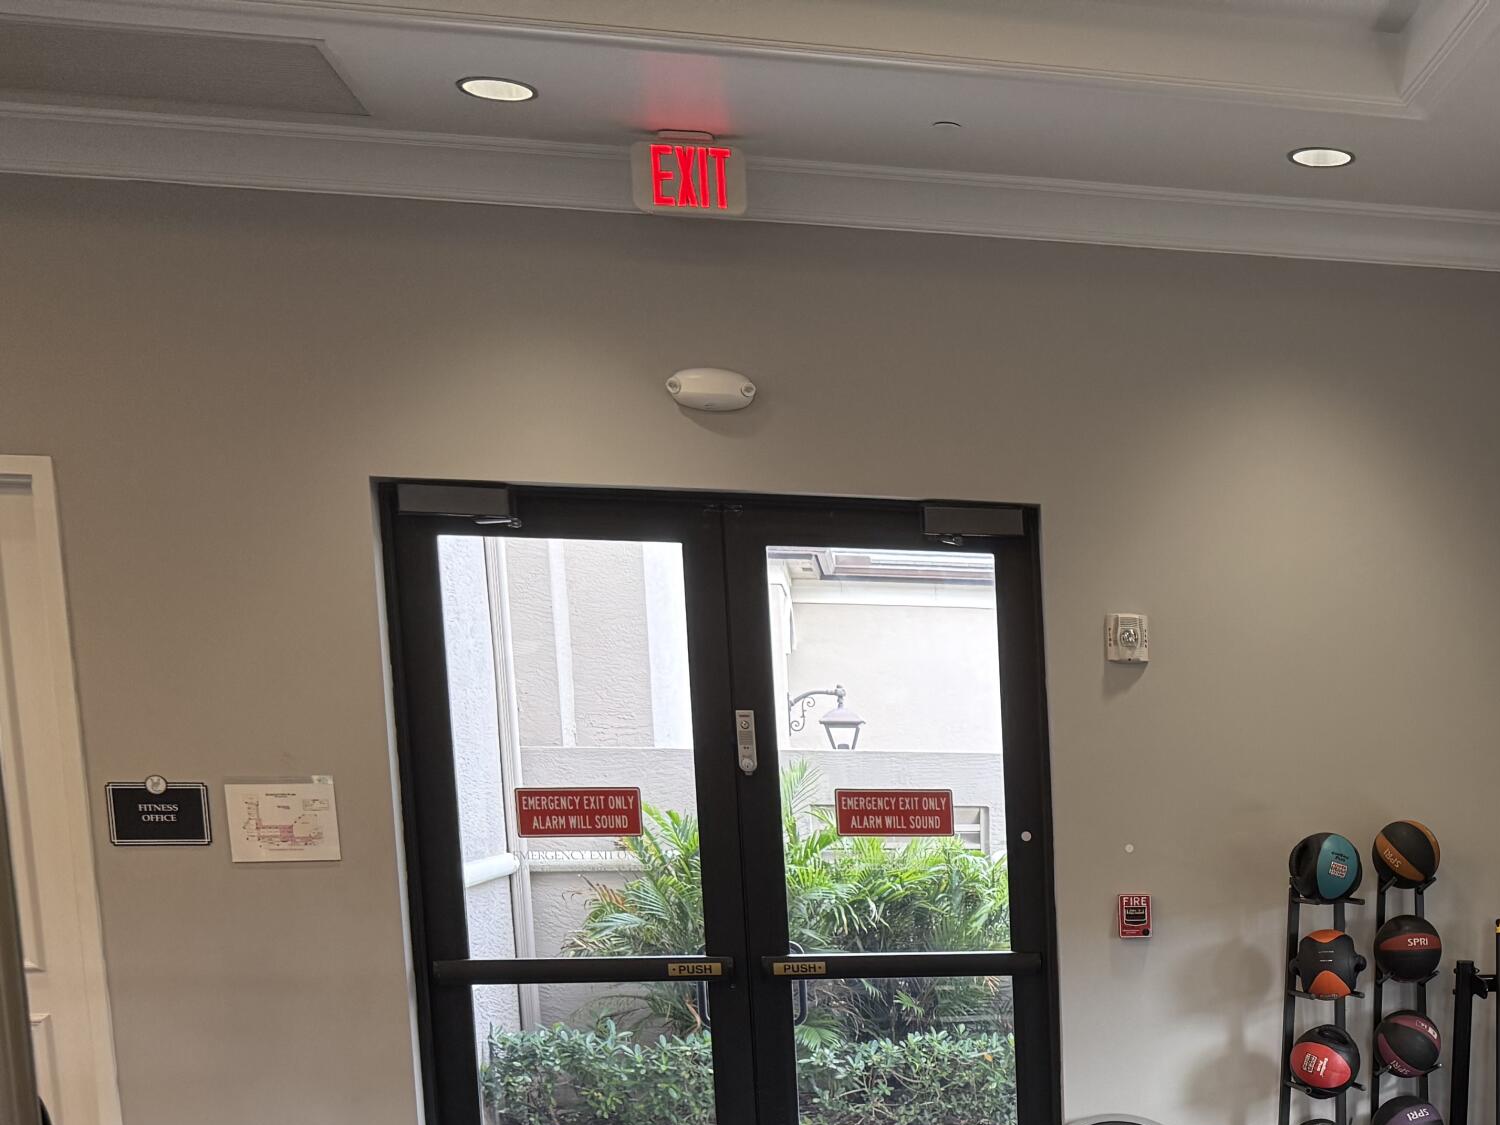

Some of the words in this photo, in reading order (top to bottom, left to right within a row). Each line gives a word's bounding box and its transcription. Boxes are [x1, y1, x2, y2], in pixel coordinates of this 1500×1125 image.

[650, 144, 731, 209] EXIT
[138, 804, 179, 812] FITNESS
[522, 796, 580, 810] EMERGENCY
[584, 796, 605, 810] EXIT
[609, 795, 634, 809] ONLY
[842, 797, 896, 810] EMERGENCY
[900, 797, 919, 810] EXIT
[922, 797, 946, 810] ONLY
[142, 814, 177, 822] OFFICE
[533, 816, 566, 829] ALARM
[569, 816, 592, 829] WILL
[595, 815, 628, 828] SOUND
[851, 816, 882, 829] ALARM
[885, 816, 906, 829] WILL
[909, 816, 940, 829] SOUND
[1384, 848, 1401, 869] SPRI
[1123, 896, 1147, 906] FIRE
[1407, 937, 1429, 947] SPRI
[678, 965, 713, 974] PUSH
[783, 964, 816, 973] PUSH
[1406, 1108, 1430, 1122] SPRI
